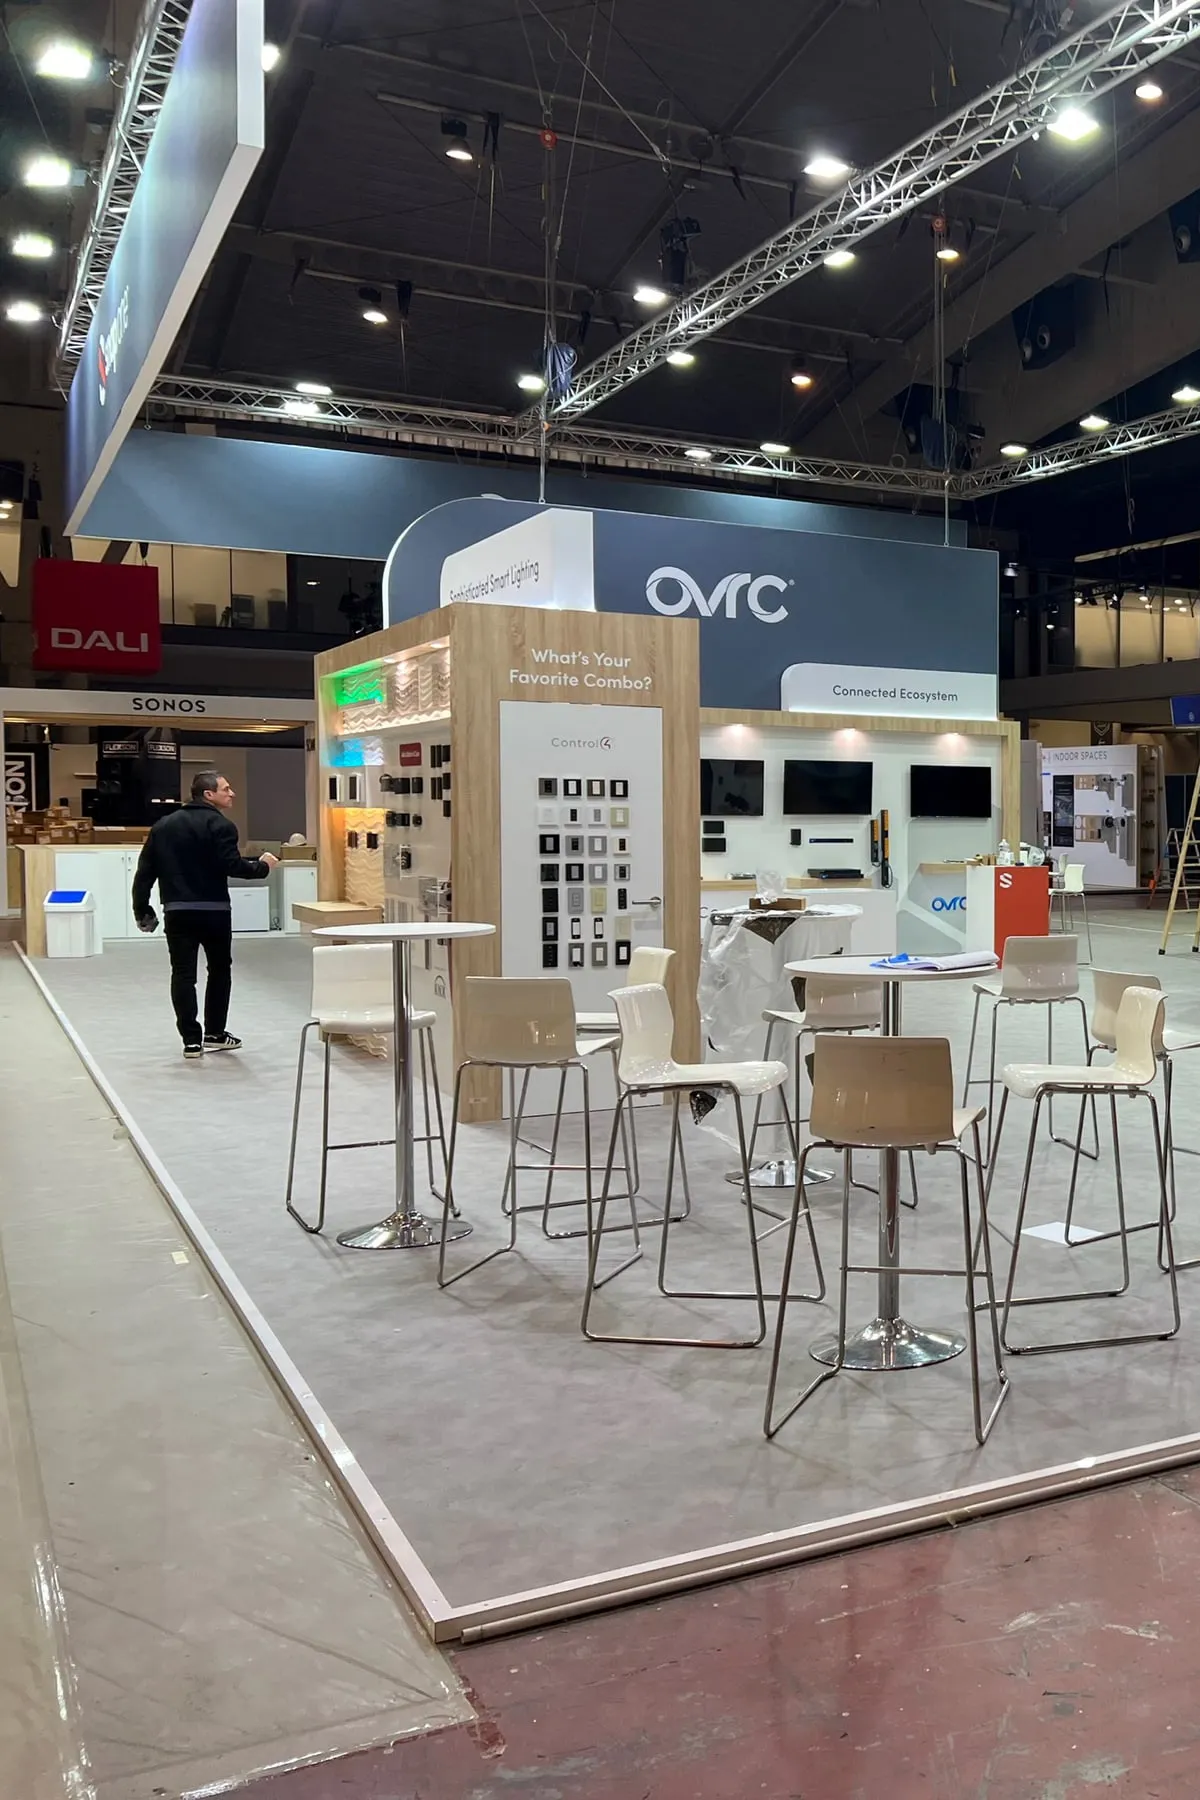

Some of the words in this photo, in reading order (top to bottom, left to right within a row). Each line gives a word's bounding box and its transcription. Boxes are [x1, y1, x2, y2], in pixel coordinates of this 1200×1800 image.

[490, 570, 510, 593] Smart
[511, 559, 540, 589] Lighting
[51, 627, 149, 653] DALI
[593, 652, 632, 668] Your
[509, 669, 579, 687] Favorite
[583, 673, 653, 690] Combo?
[832, 684, 897, 699] Connected
[900, 688, 959, 703] Ecosystem
[132, 697, 206, 713] SONOS
[1053, 752, 1079, 761] INDOOR
[1080, 751, 1108, 761] SPACES
